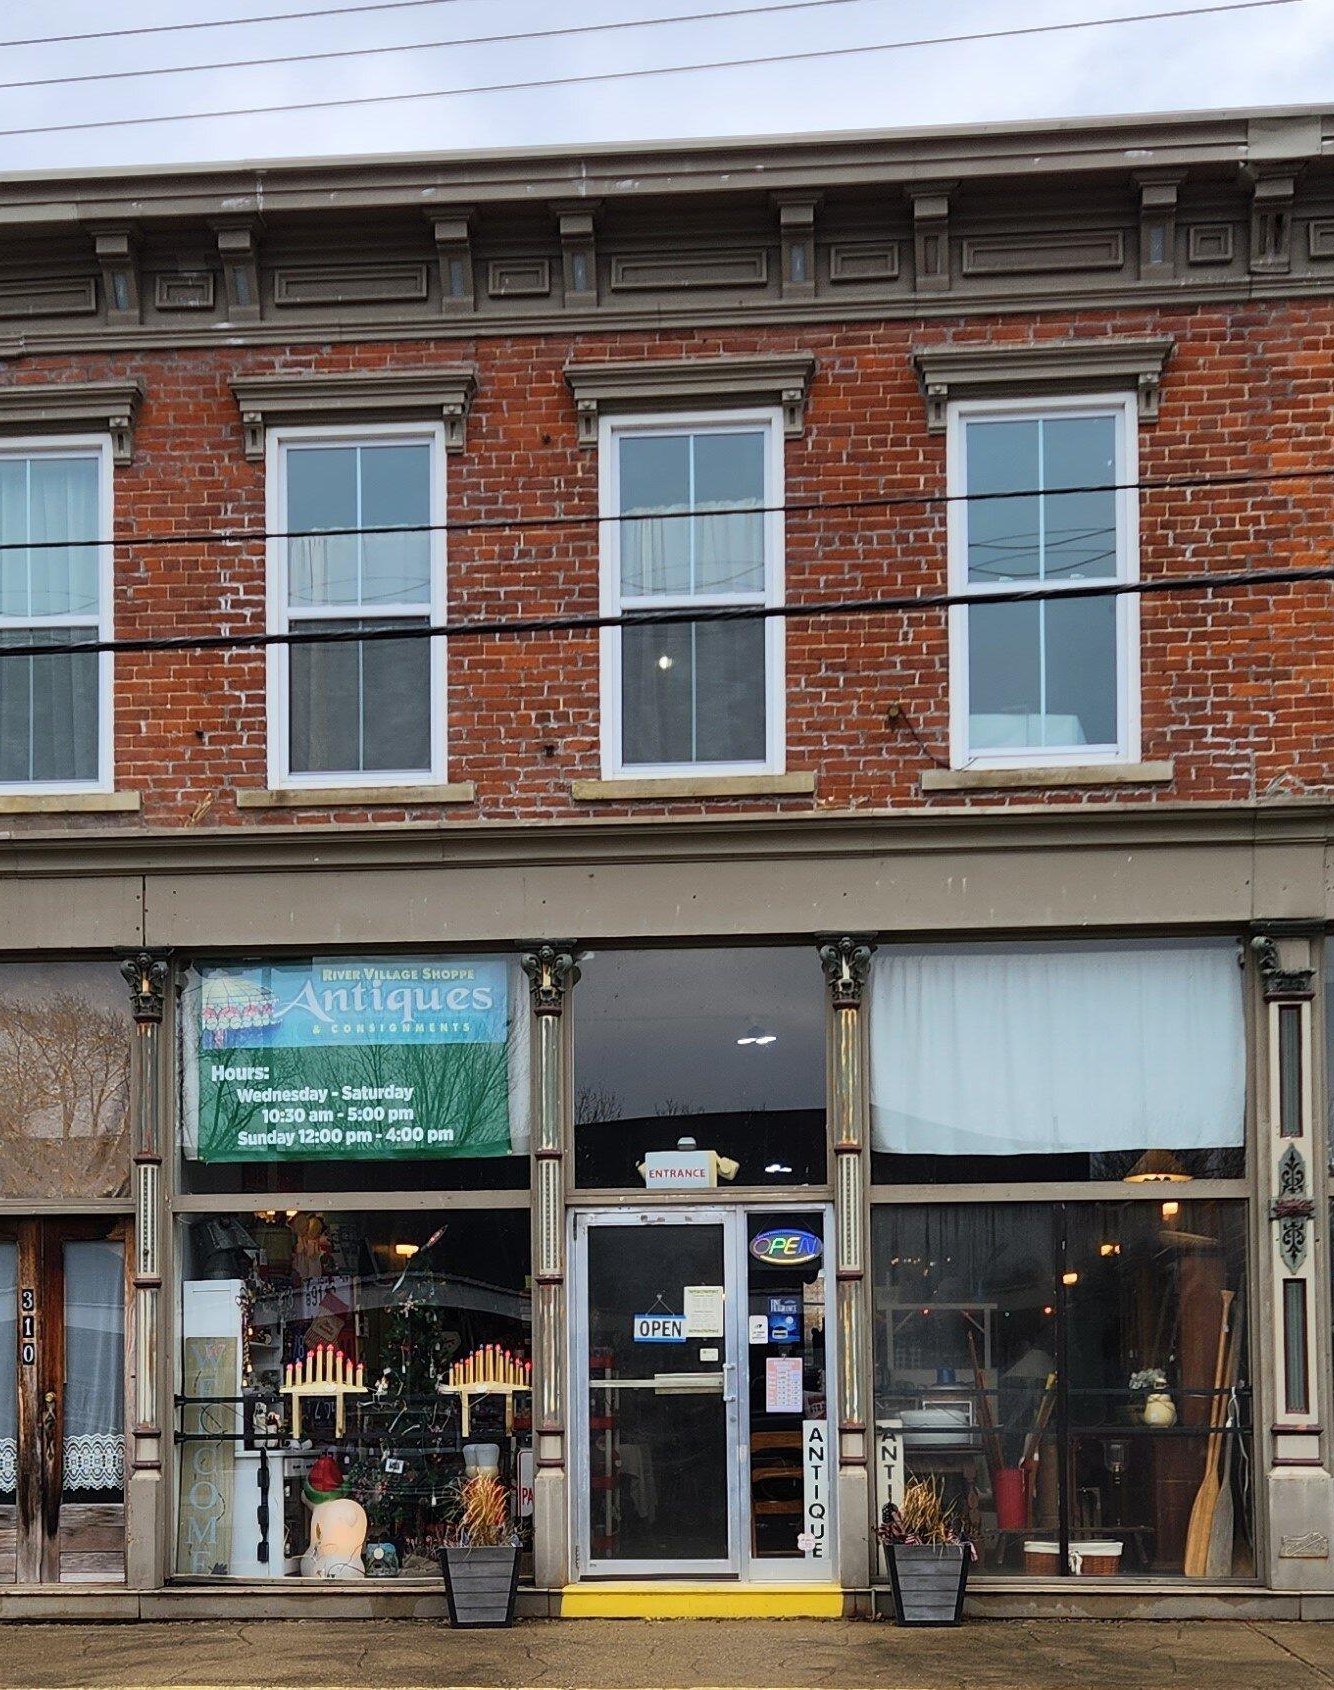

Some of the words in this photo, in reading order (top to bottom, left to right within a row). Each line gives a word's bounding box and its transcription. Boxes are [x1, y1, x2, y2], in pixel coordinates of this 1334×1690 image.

[322, 968, 360, 981] RIVER
[363, 967, 417, 980] VILLAGE
[422, 967, 474, 980] SHOPPE
[273, 979, 493, 1023] Antiques
[312, 1024, 322, 1034] &
[331, 1022, 470, 1034] CONSIGNMENTS
[211, 1065, 270, 1082] Hours:
[236, 1088, 329, 1103] Wednesday
[341, 1084, 414, 1102] Saturday
[262, 1108, 305, 1124] 10:30
[308, 1110, 333, 1122] am
[347, 1107, 385, 1121] 5:00
[387, 1108, 414, 1123] pm
[237, 1130, 295, 1147] Sunday
[298, 1128, 342, 1144] 12:00
[345, 1130, 372, 1145] pm
[385, 1127, 424, 1142] 4:00
[427, 1128, 454, 1144] pm
[649, 1168, 706, 1178] ENTRANCE
[753, 1236, 817, 1255] OPEN
[23, 1291, 34, 1362] 310
[640, 1320, 682, 1337] OPEN
[808, 1427, 826, 1558] ANTIQUE
